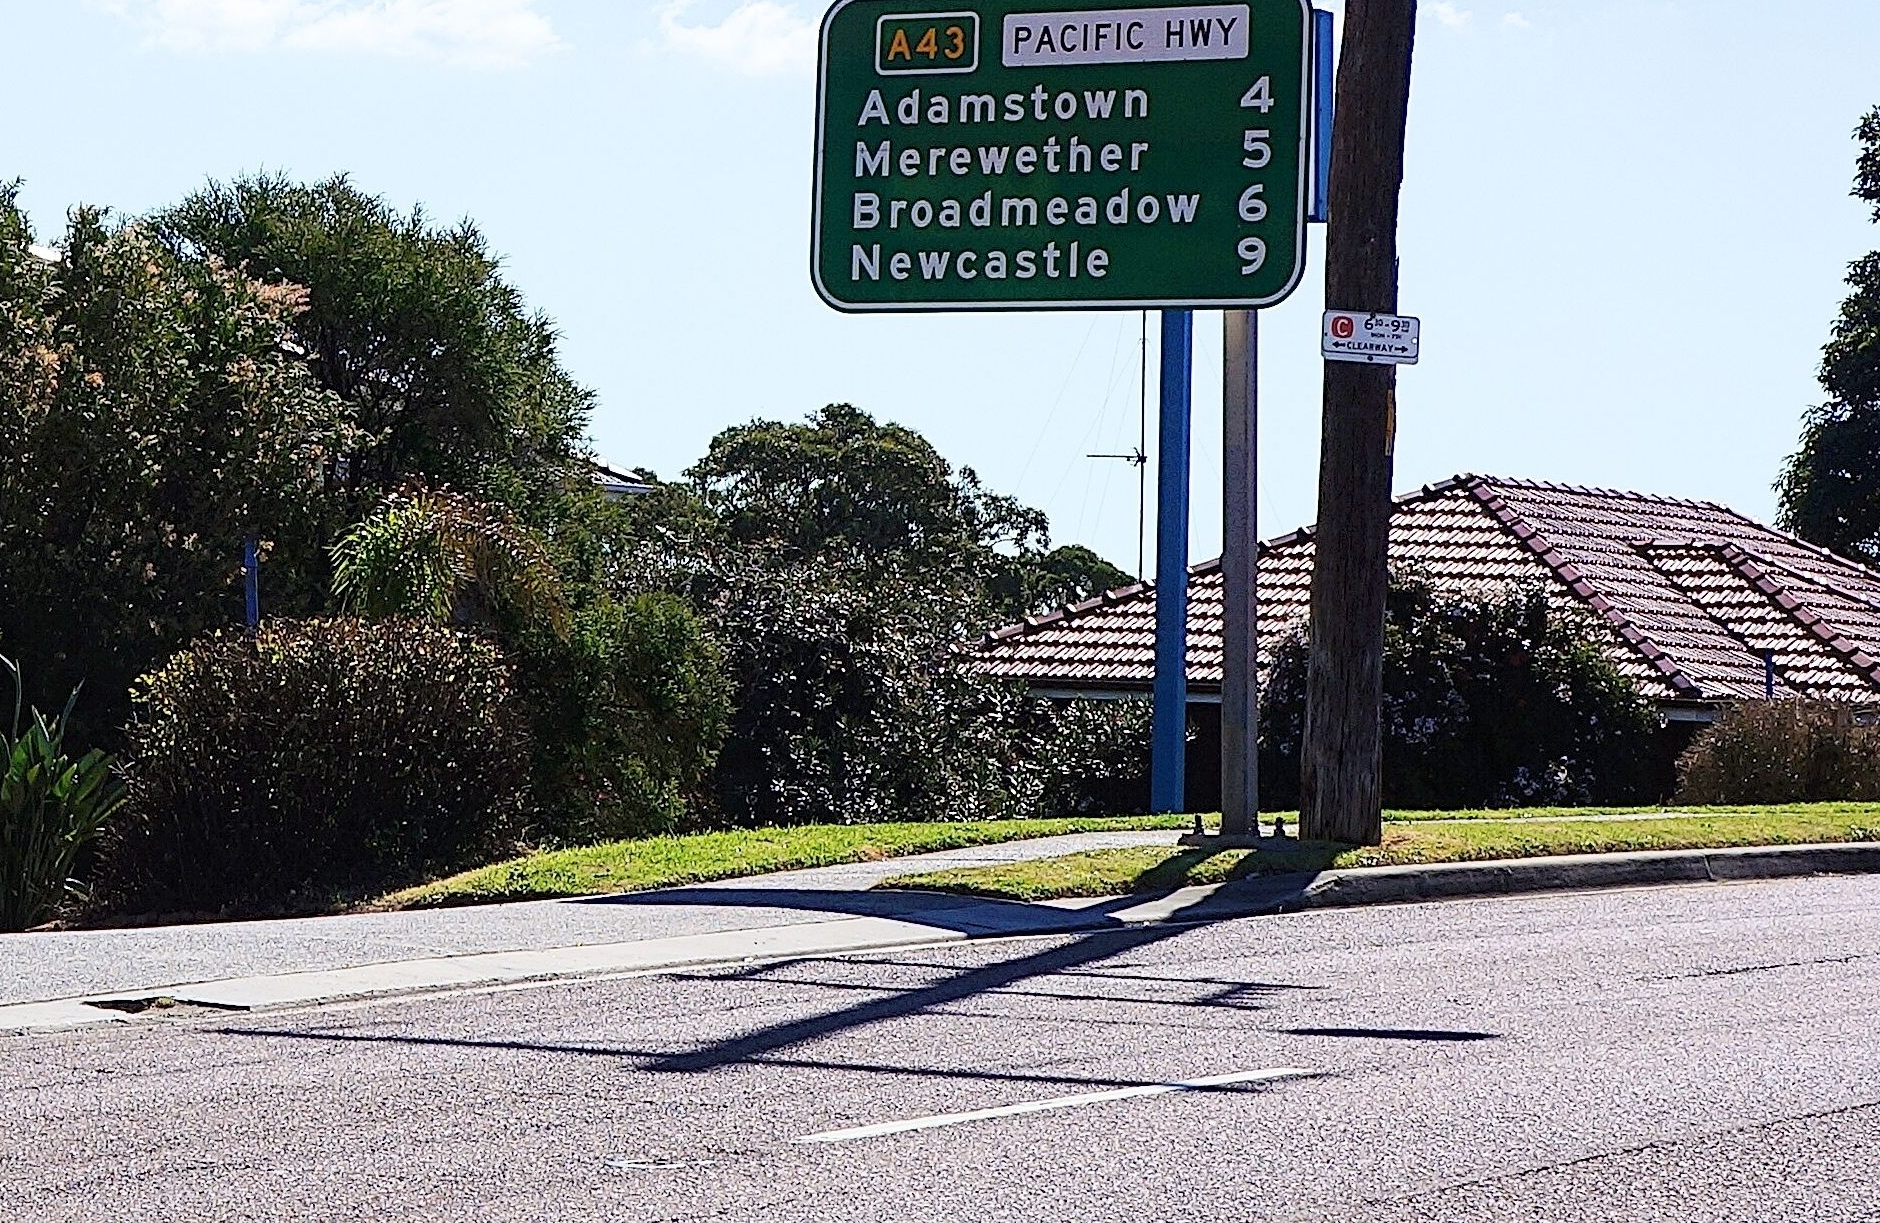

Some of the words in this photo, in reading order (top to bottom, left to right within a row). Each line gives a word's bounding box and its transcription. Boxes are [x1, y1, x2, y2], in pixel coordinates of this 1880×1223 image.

[887, 26, 966, 62] A43
[1013, 21, 1145, 55] PACIFIC
[1165, 17, 1238, 49] HWY
[858, 83, 1149, 126] Adamstown
[1240, 75, 1275, 114] 4
[855, 135, 1149, 177] Merewether
[1242, 129, 1271, 169] 5
[852, 187, 1200, 229] Broadmeadow
[1238, 183, 1267, 223] 6
[851, 241, 1110, 281] Newcastle
[1237, 237, 1267, 275] 9
[1337, 319, 1348, 336] C
[1347, 341, 1393, 352] CLEARWAY
